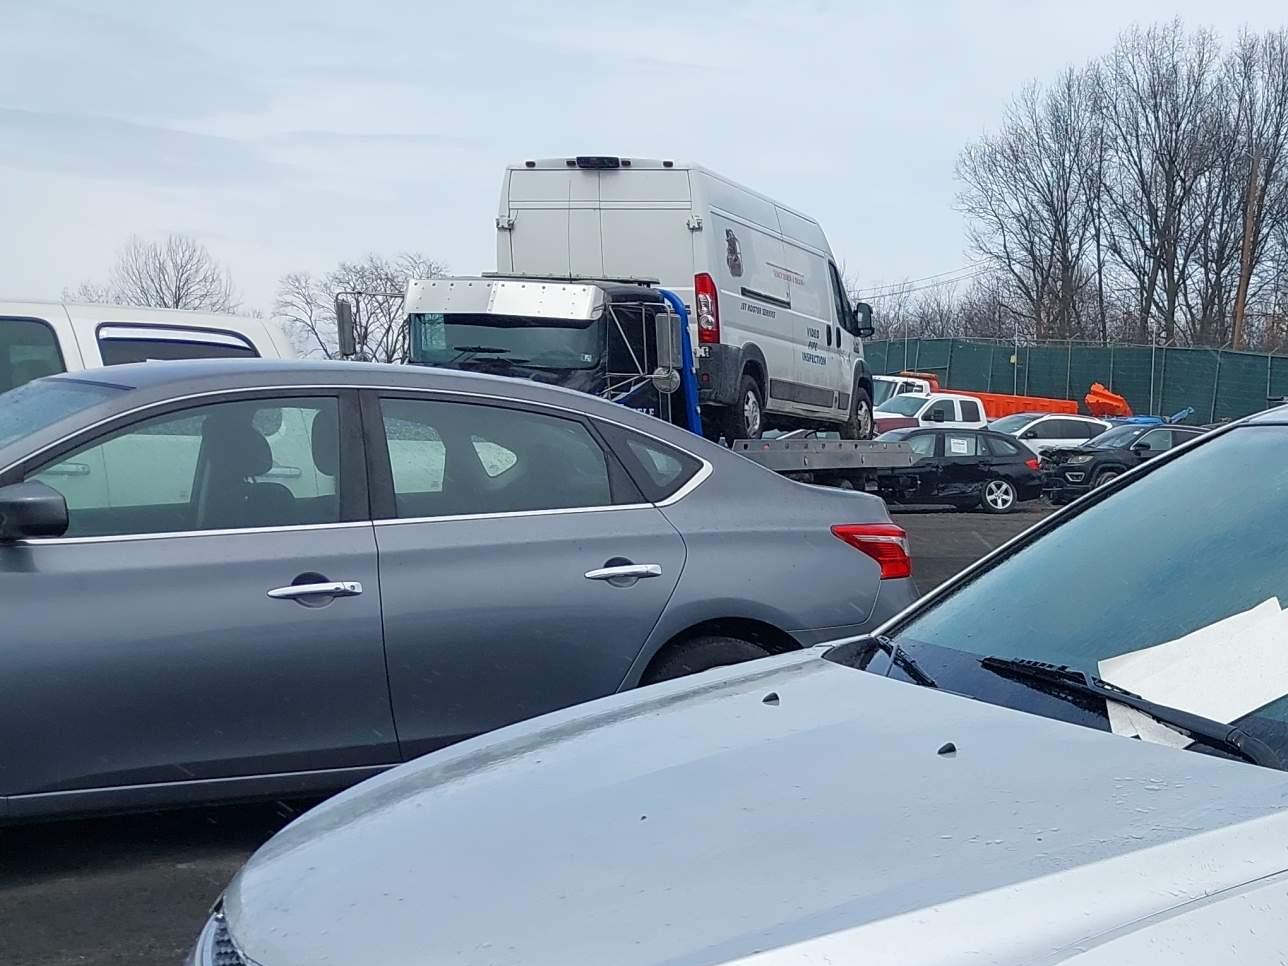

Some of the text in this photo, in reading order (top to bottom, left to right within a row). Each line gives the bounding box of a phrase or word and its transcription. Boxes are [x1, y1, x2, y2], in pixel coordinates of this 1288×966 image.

[807, 328, 820, 339] VIDEO
[808, 341, 818, 351] PIPE
[802, 353, 827, 365] INSPECTION
